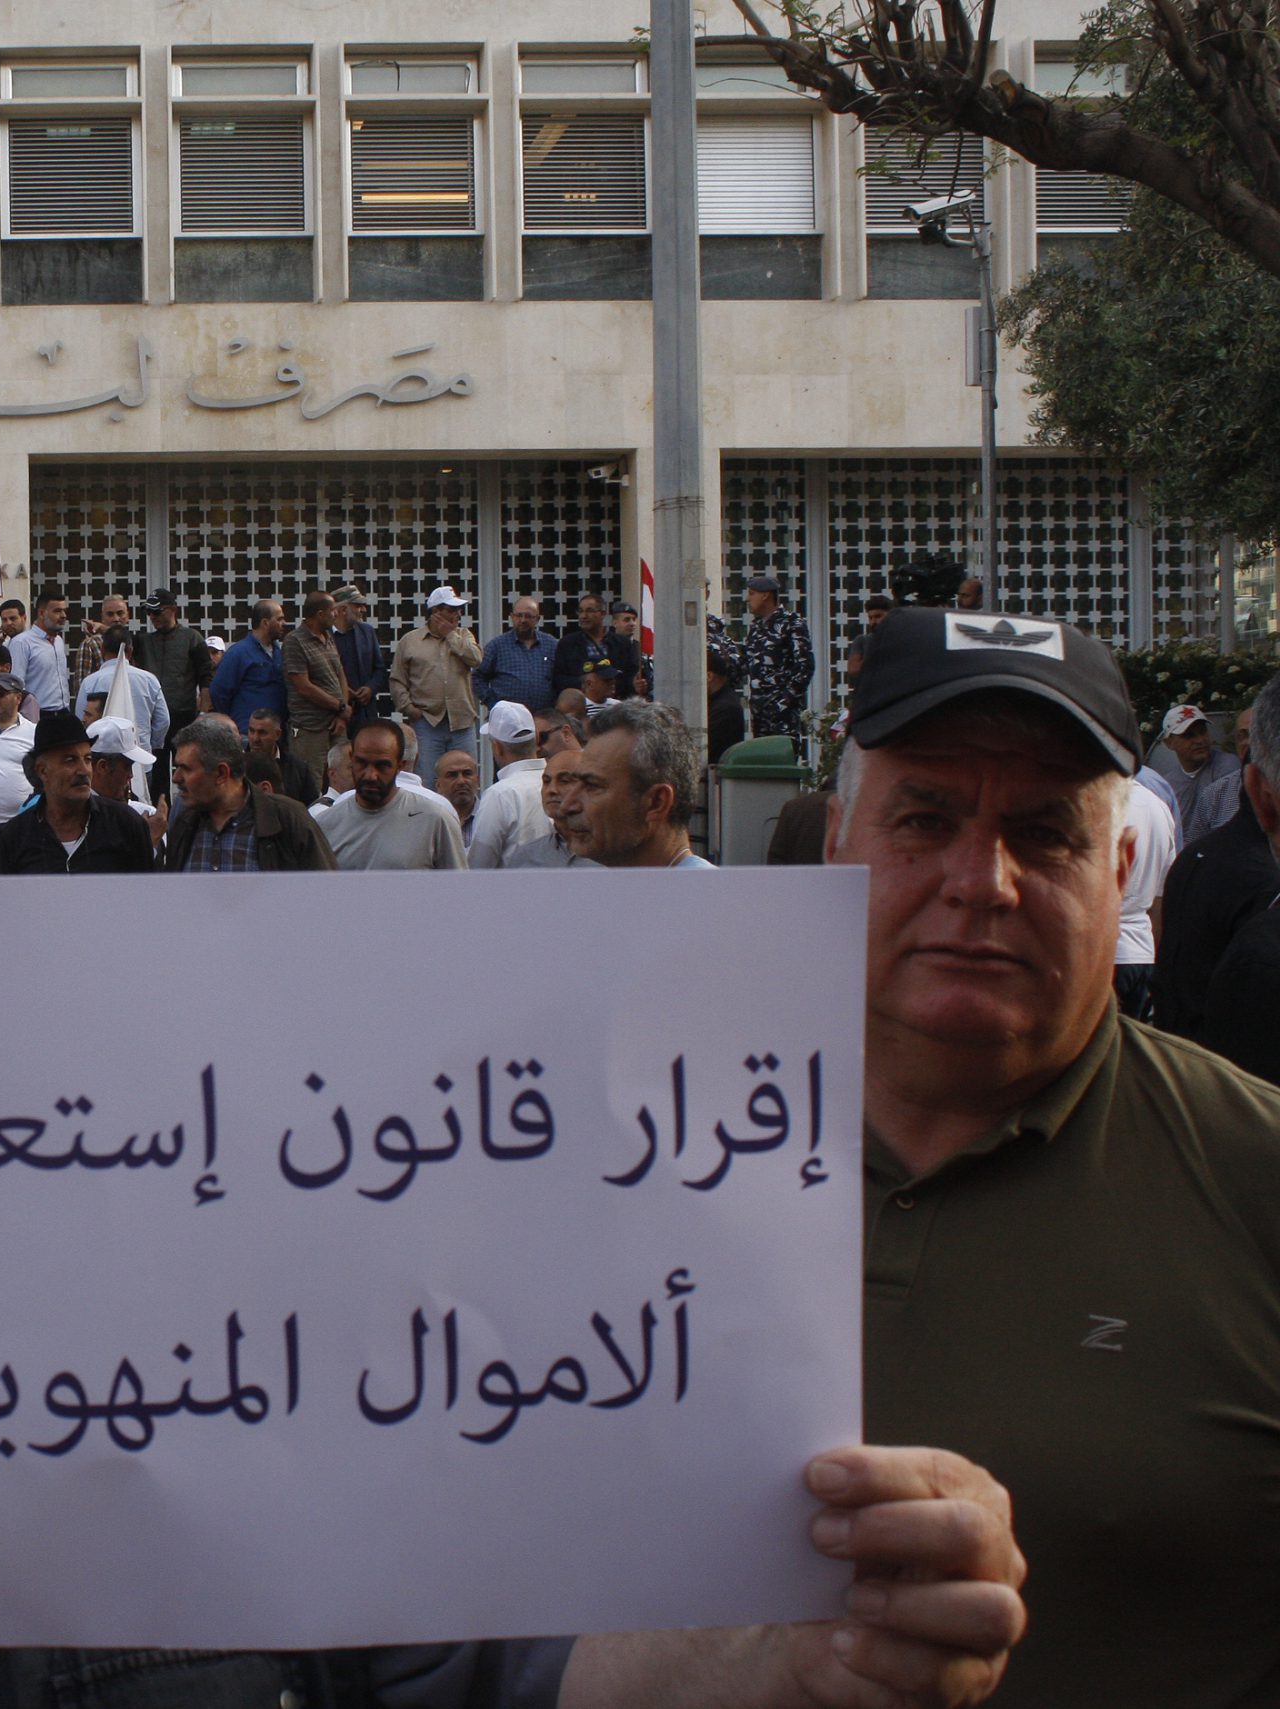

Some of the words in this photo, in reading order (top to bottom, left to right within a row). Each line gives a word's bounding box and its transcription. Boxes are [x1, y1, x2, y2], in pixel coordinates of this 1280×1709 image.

[185, 337, 475, 421] مصرف
[277, 1056, 557, 1203] قانون
[602, 1050, 831, 1192] إقرار
[355, 1267, 696, 1447] ألاموال
